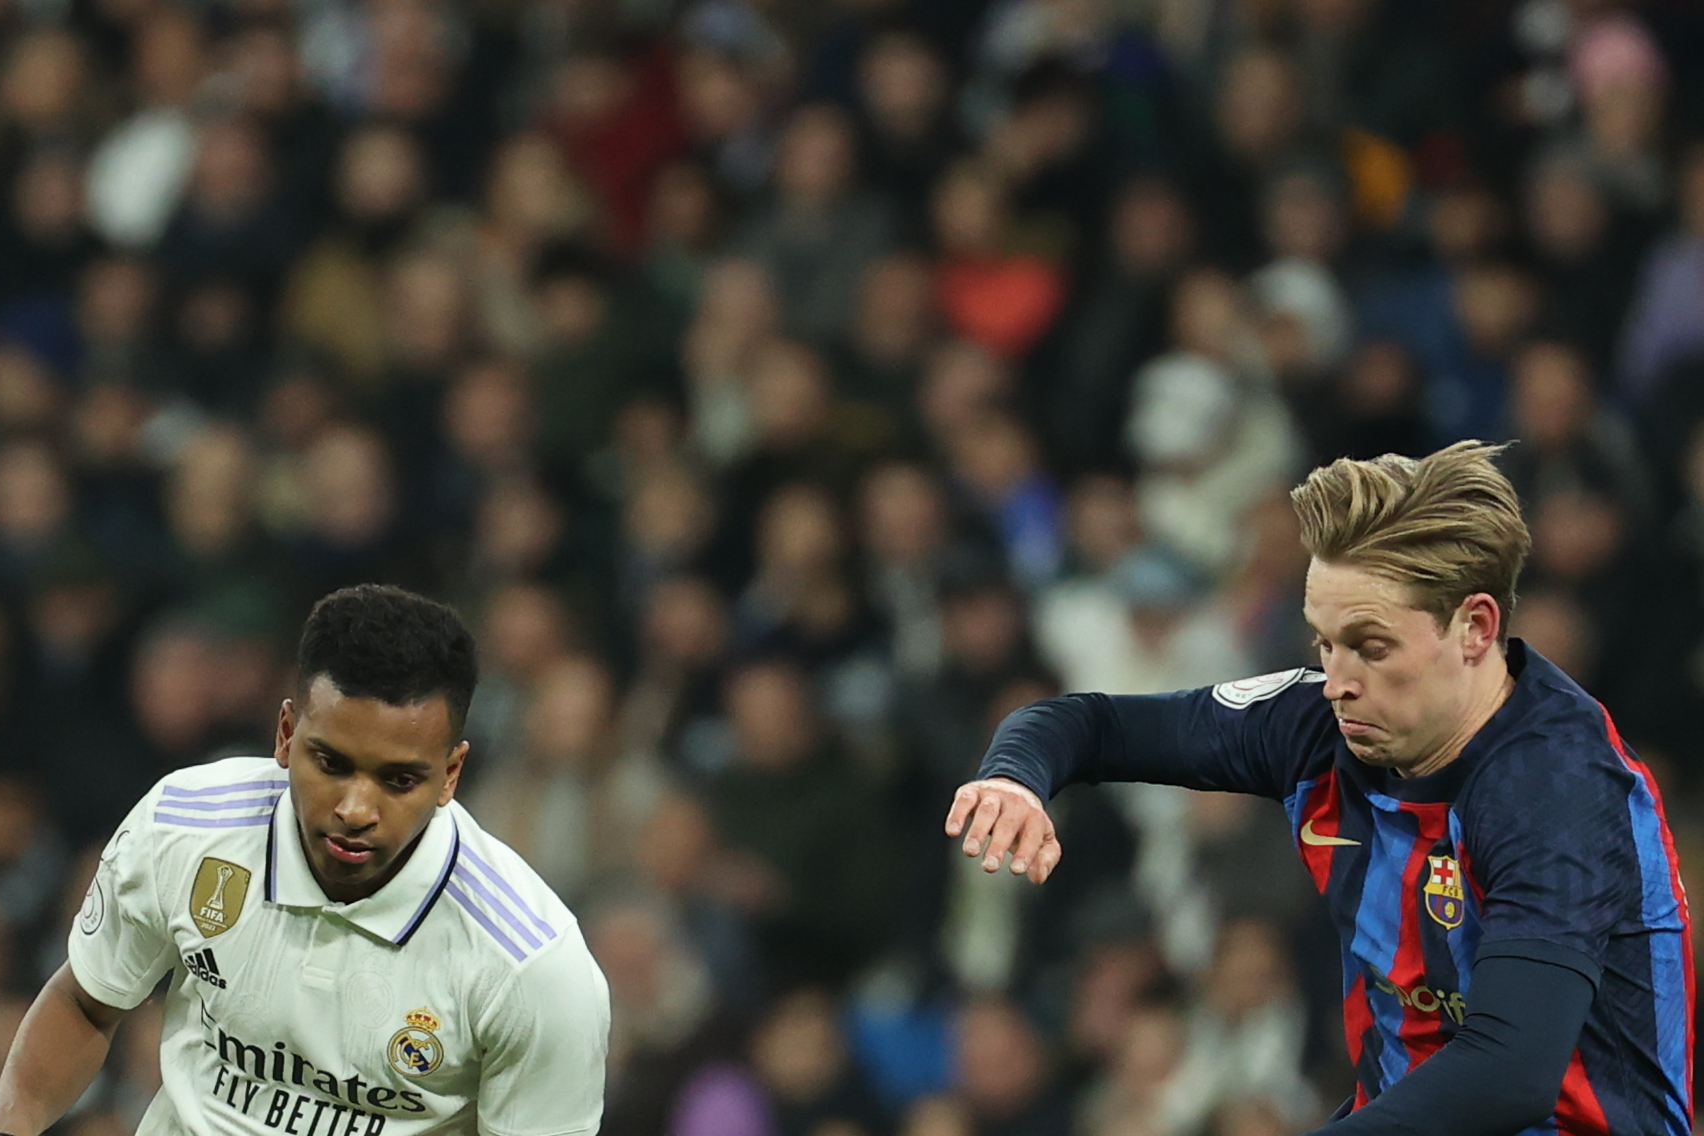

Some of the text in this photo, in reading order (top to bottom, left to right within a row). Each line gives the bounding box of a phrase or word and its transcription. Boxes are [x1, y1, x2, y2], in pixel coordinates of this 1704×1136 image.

[1442, 885, 1459, 897] FCB
[199, 906, 224, 923] FIFA
[184, 957, 227, 990] adidas
[212, 1065, 261, 1115] FLY
